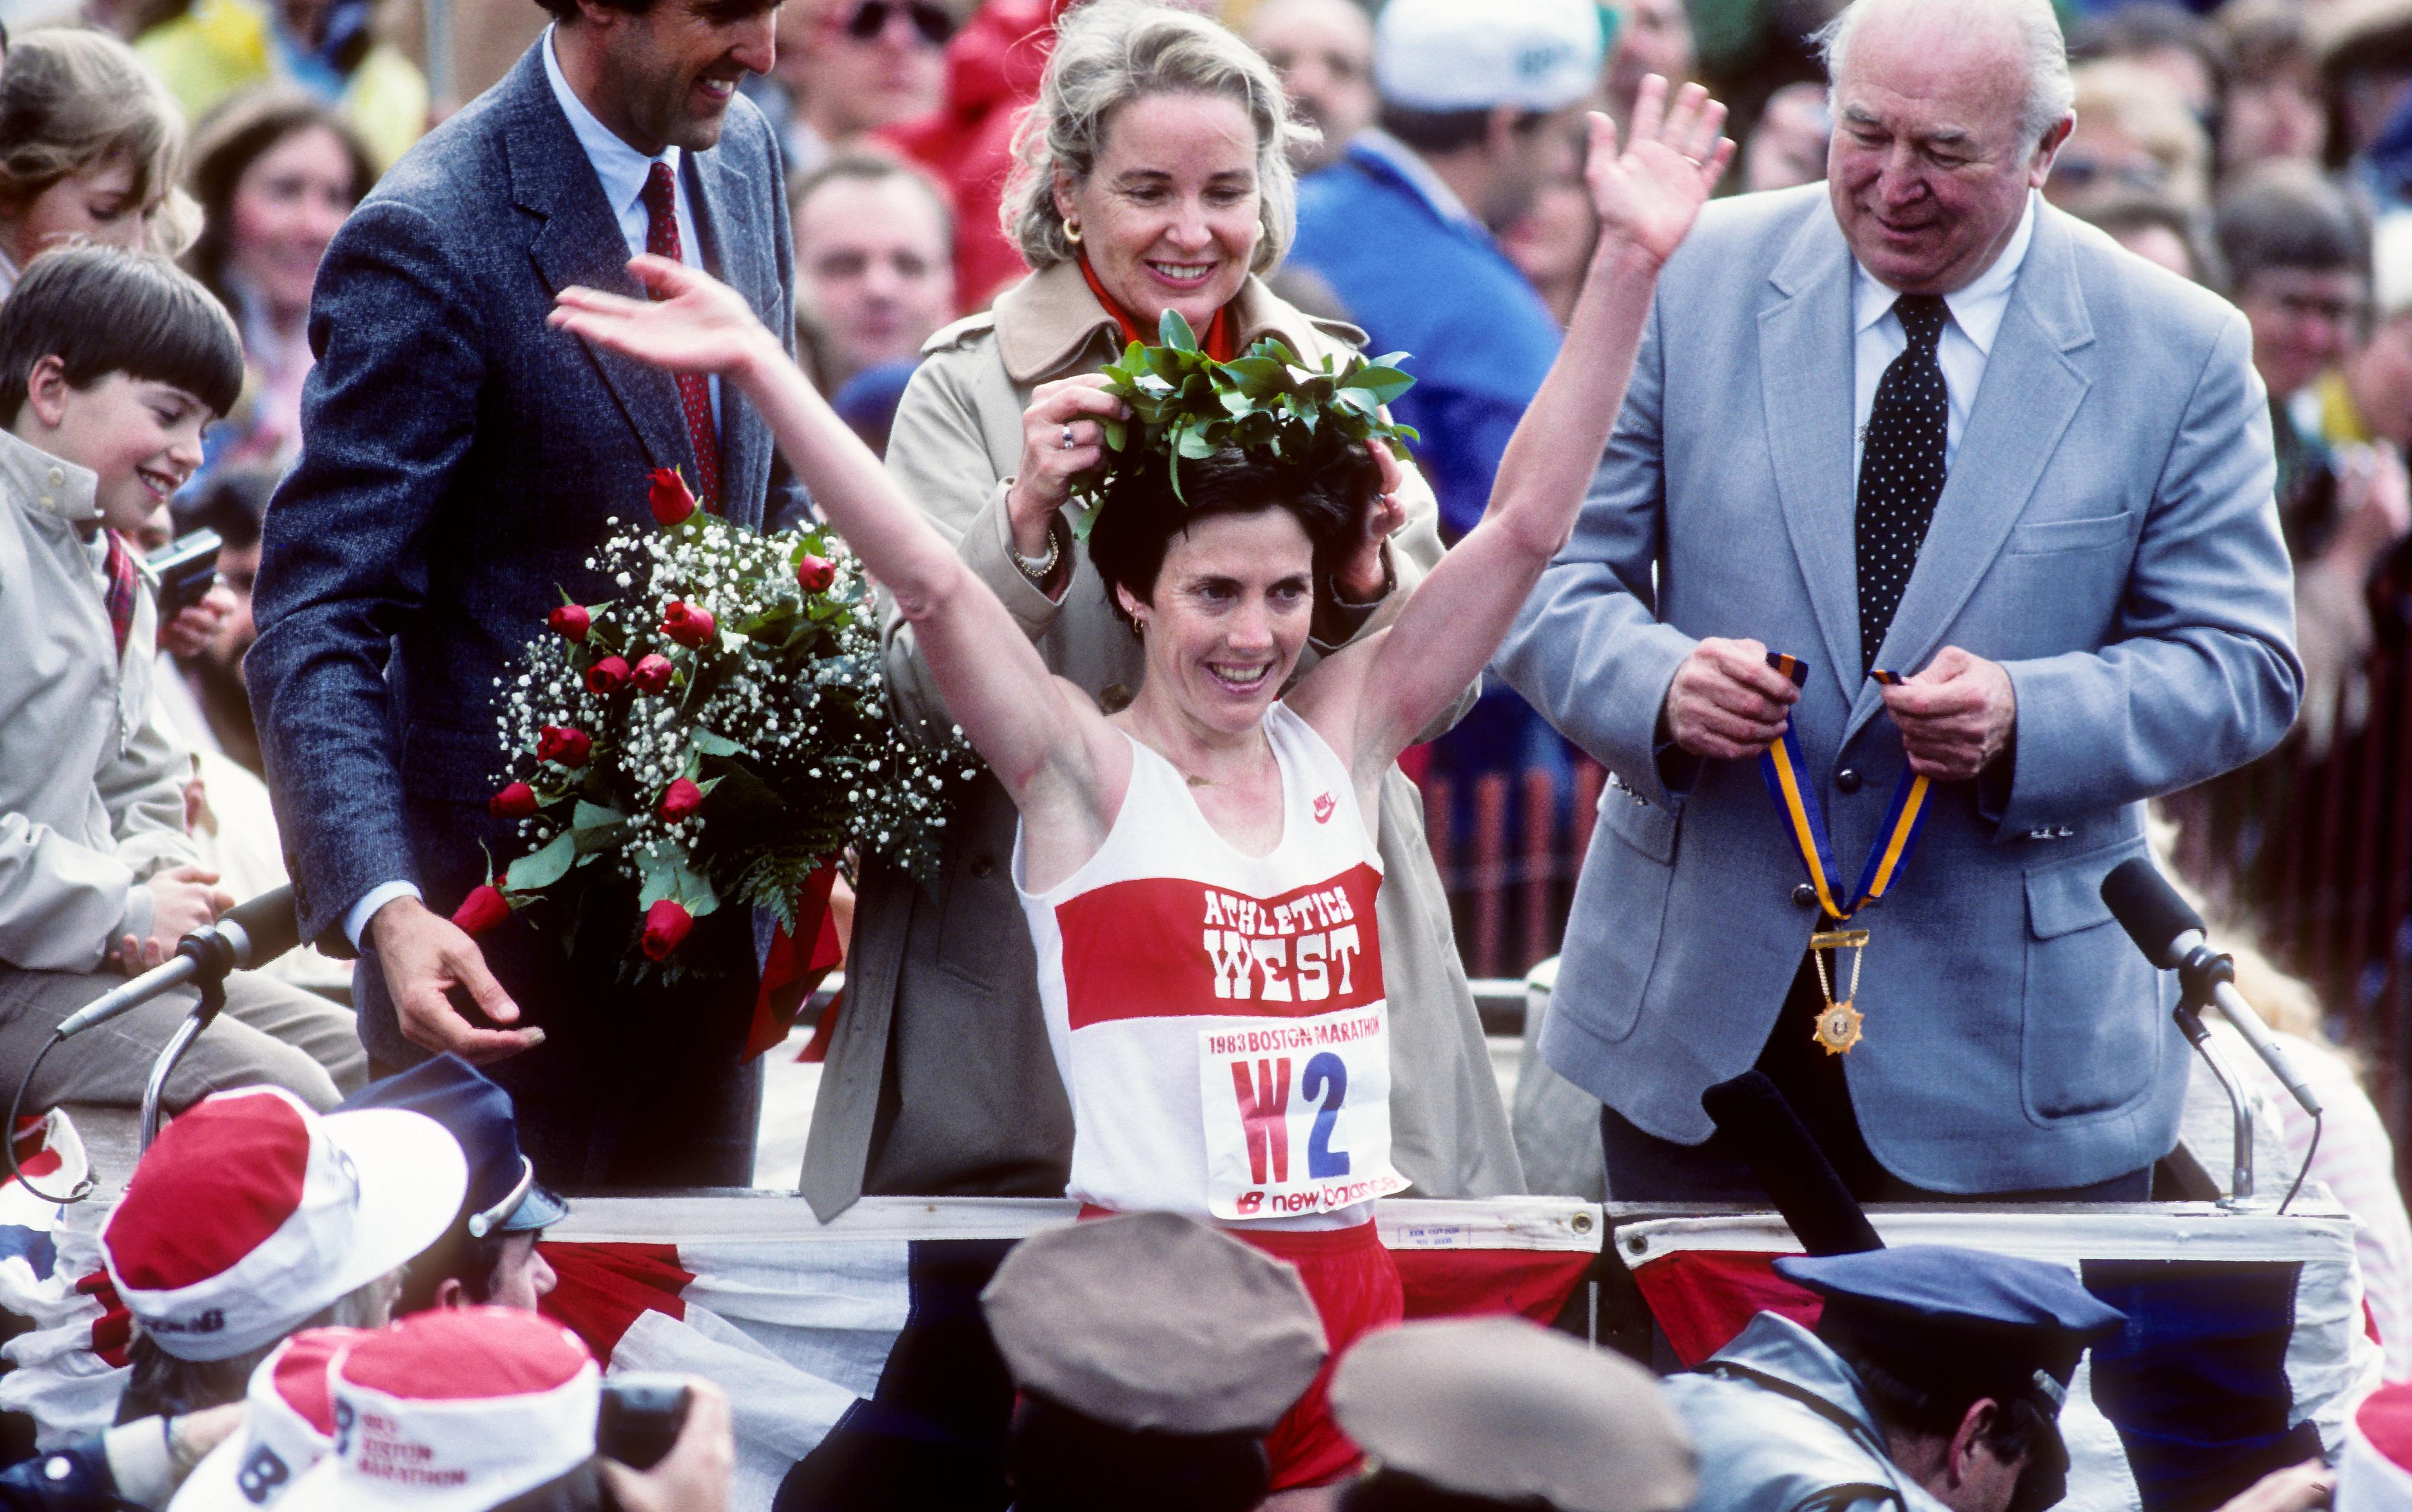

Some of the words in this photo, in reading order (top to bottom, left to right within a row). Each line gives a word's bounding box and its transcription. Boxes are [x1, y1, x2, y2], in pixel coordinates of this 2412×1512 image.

[1204, 885, 1354, 935] ATHLETICS
[1203, 924, 1360, 1002] WEST
[1209, 1033, 1246, 1054] 1983
[1248, 1027, 1314, 1053] BOSTON
[1314, 1015, 1379, 1045] MARATHON
[1271, 1190, 1320, 1212] new
[1322, 1176, 1399, 1207] balance
